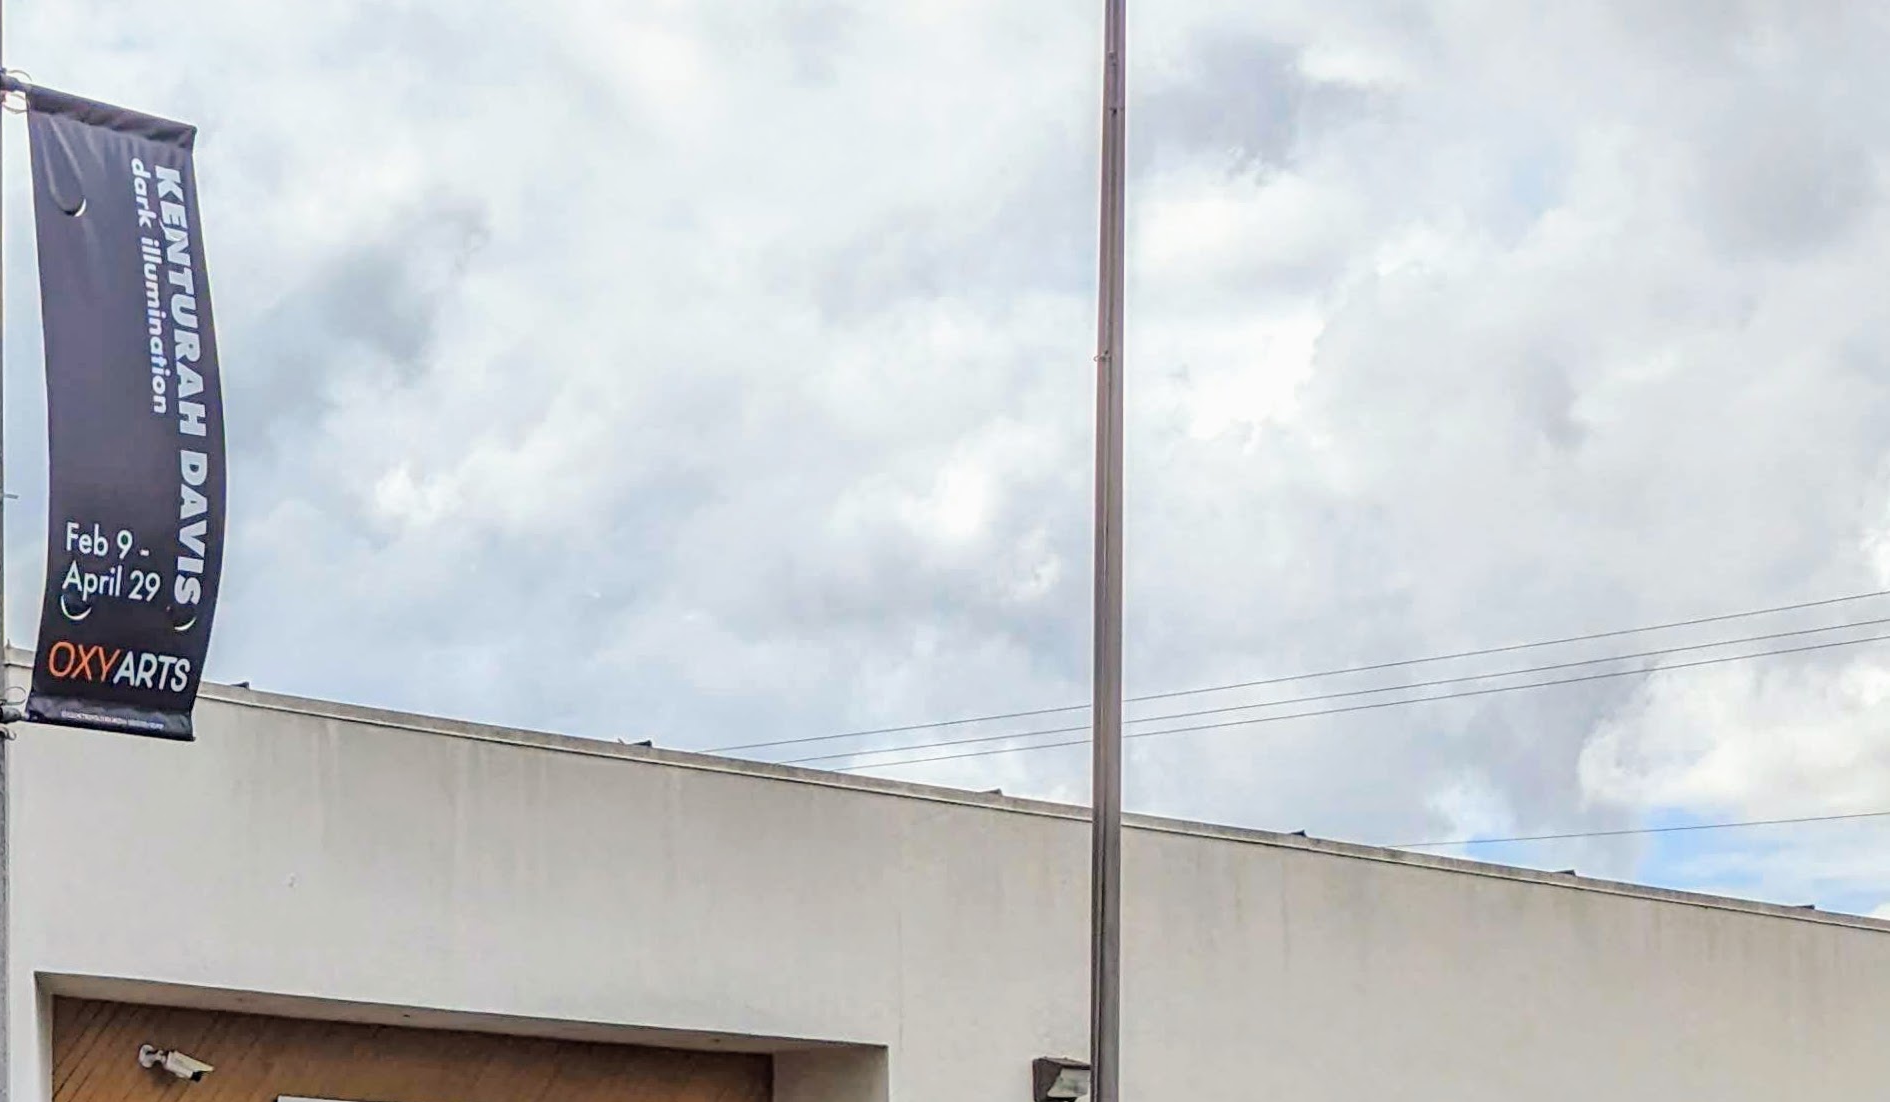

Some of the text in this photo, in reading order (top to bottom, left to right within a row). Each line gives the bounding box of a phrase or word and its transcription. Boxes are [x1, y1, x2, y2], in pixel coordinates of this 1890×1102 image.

[130, 158, 171, 414] dark illumination
[155, 165, 208, 605] KENTURAH DAVIS
[62, 560, 161, 602] April 29
[66, 522, 109, 556] Feb
[116, 530, 133, 559] 9
